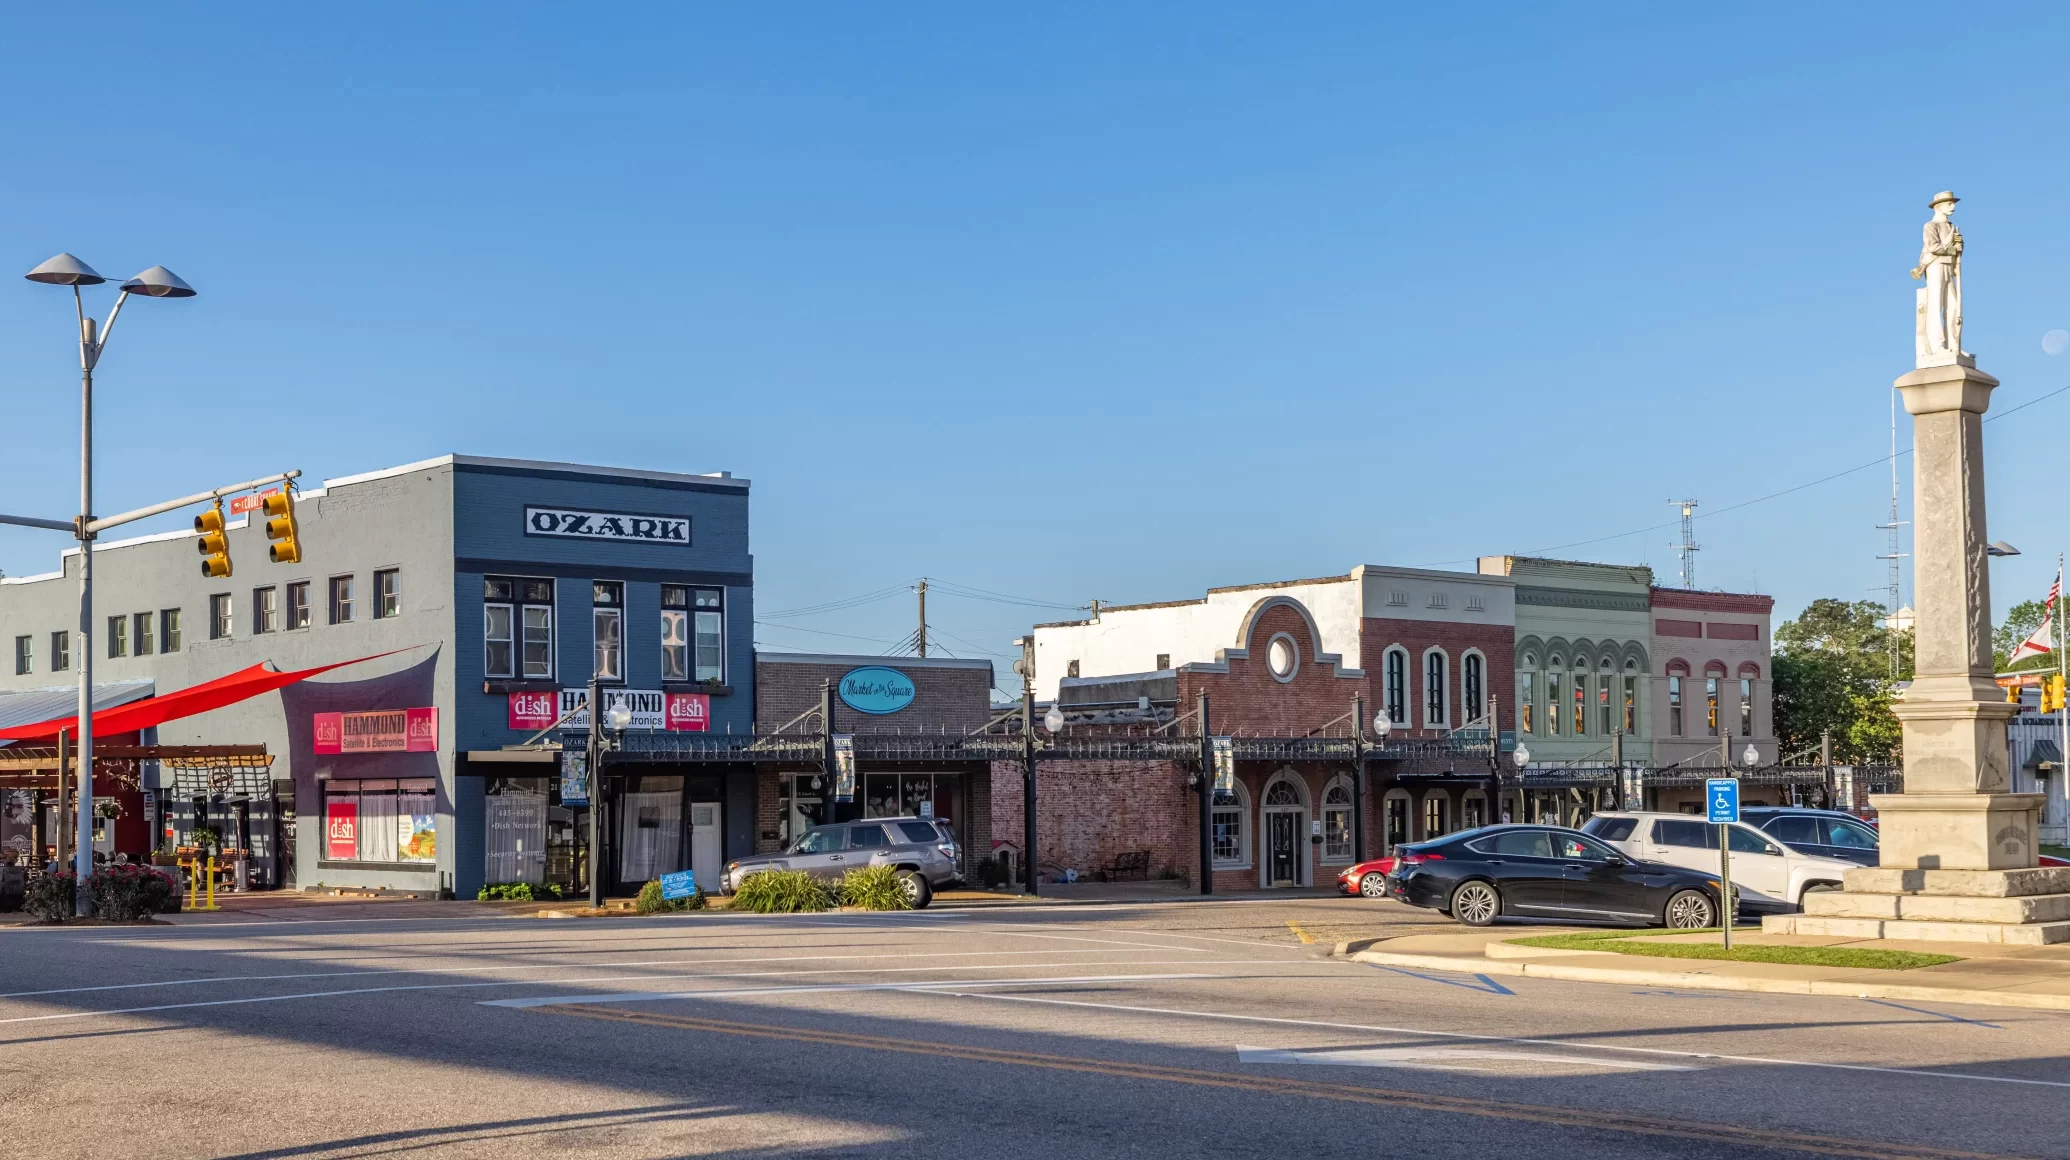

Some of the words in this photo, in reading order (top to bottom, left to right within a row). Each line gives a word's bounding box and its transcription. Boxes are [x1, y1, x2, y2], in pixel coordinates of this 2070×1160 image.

[531, 512, 686, 540] OZARK
[843, 679, 873, 696] Market
[885, 680, 912, 700] Square
[515, 695, 552, 715] dish
[671, 698, 704, 717] dish
[317, 722, 338, 741] dish
[343, 713, 405, 736] HAMMOND
[410, 717, 433, 737] dish
[343, 738, 365, 749] Satellite
[366, 738, 371, 747] &
[371, 737, 405, 748] Electronics
[500, 786, 534, 797] Hammond
[330, 817, 354, 839] dish
